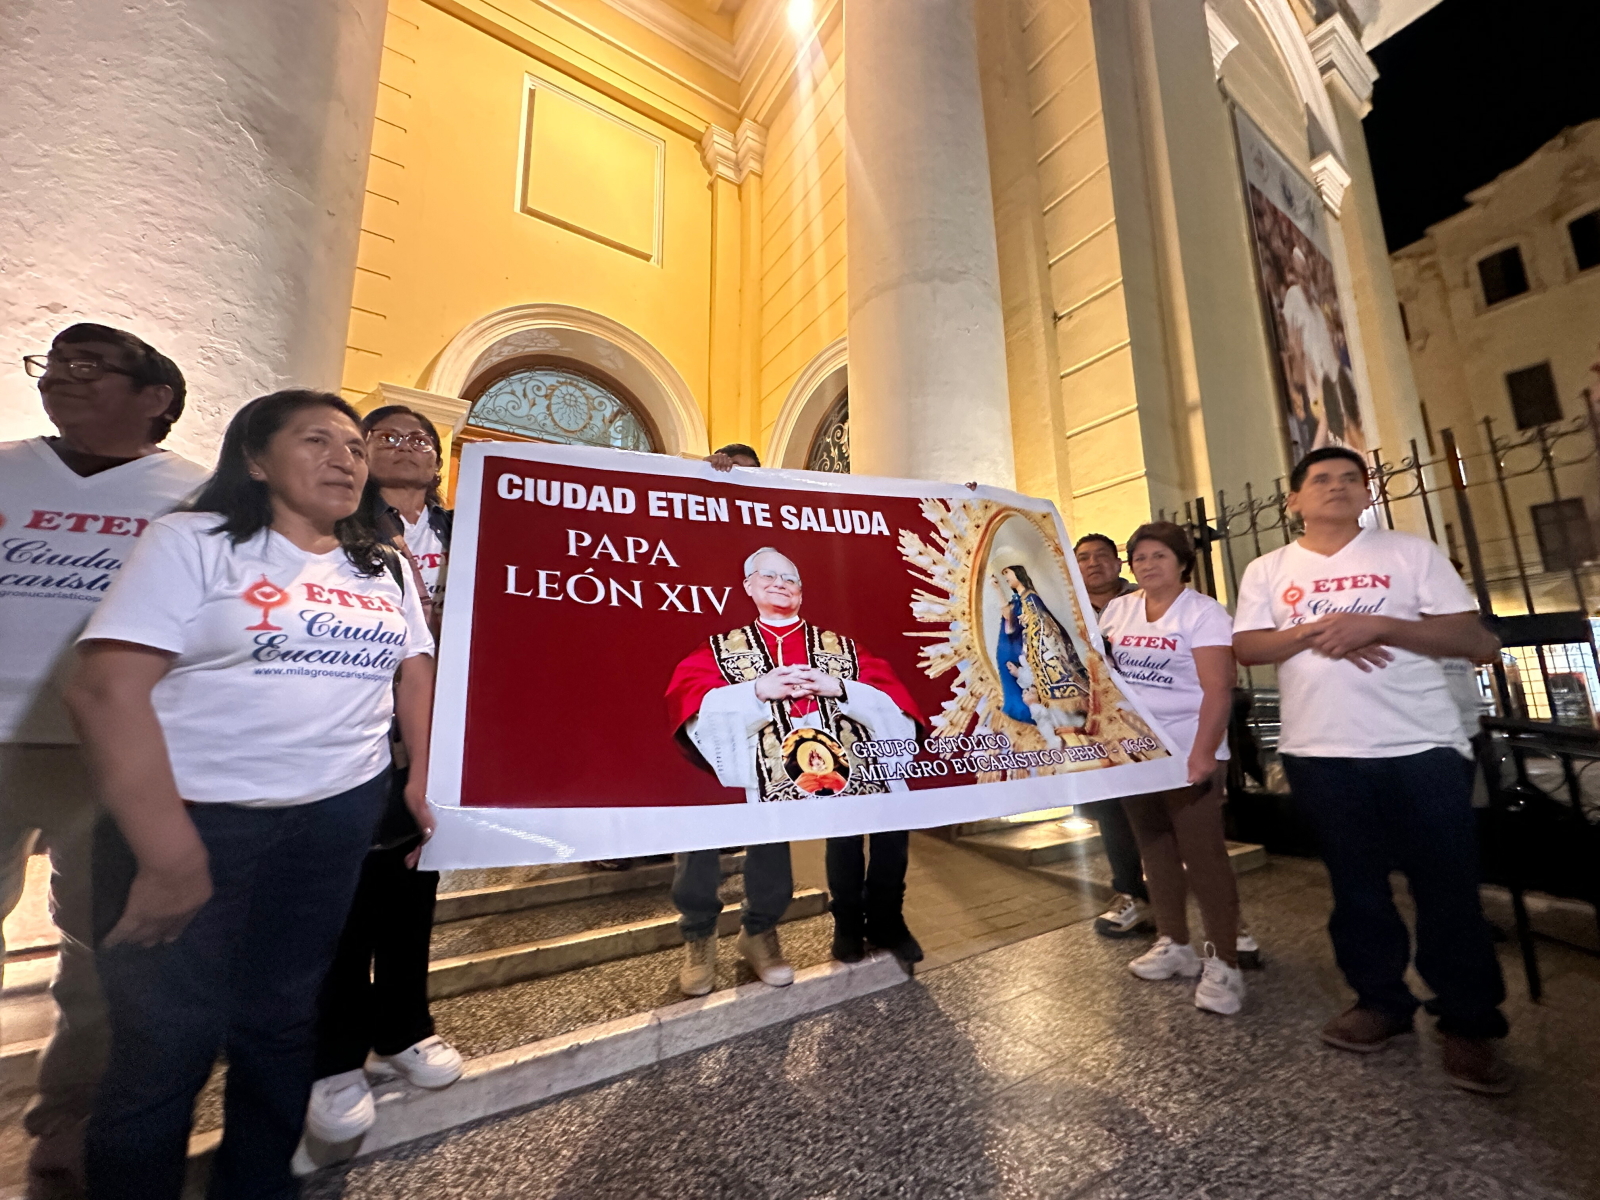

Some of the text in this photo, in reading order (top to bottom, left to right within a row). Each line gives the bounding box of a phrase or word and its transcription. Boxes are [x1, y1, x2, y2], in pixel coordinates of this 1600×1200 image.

[497, 473, 890, 536] CIUDAD ETEN TE SALUDA
[2, 537, 123, 571] Ciuda
[566, 529, 681, 568] PAPA
[504, 565, 732, 616] LEÓN XIV
[1311, 574, 1391, 594] ETEN
[1307, 597, 1386, 616] Ciudad
[299, 609, 408, 647] Ciudad
[1119, 635, 1178, 652] ETEN
[1115, 651, 1172, 671] Ciudad
[852, 733, 1011, 759] GRUPO CATÓLICO
[857, 760, 948, 782] MILAGRO
[953, 748, 1064, 775] EUCARÍSTICO
[1065, 743, 1110, 763] PERÚ
[1120, 736, 1157, 755] 1649
